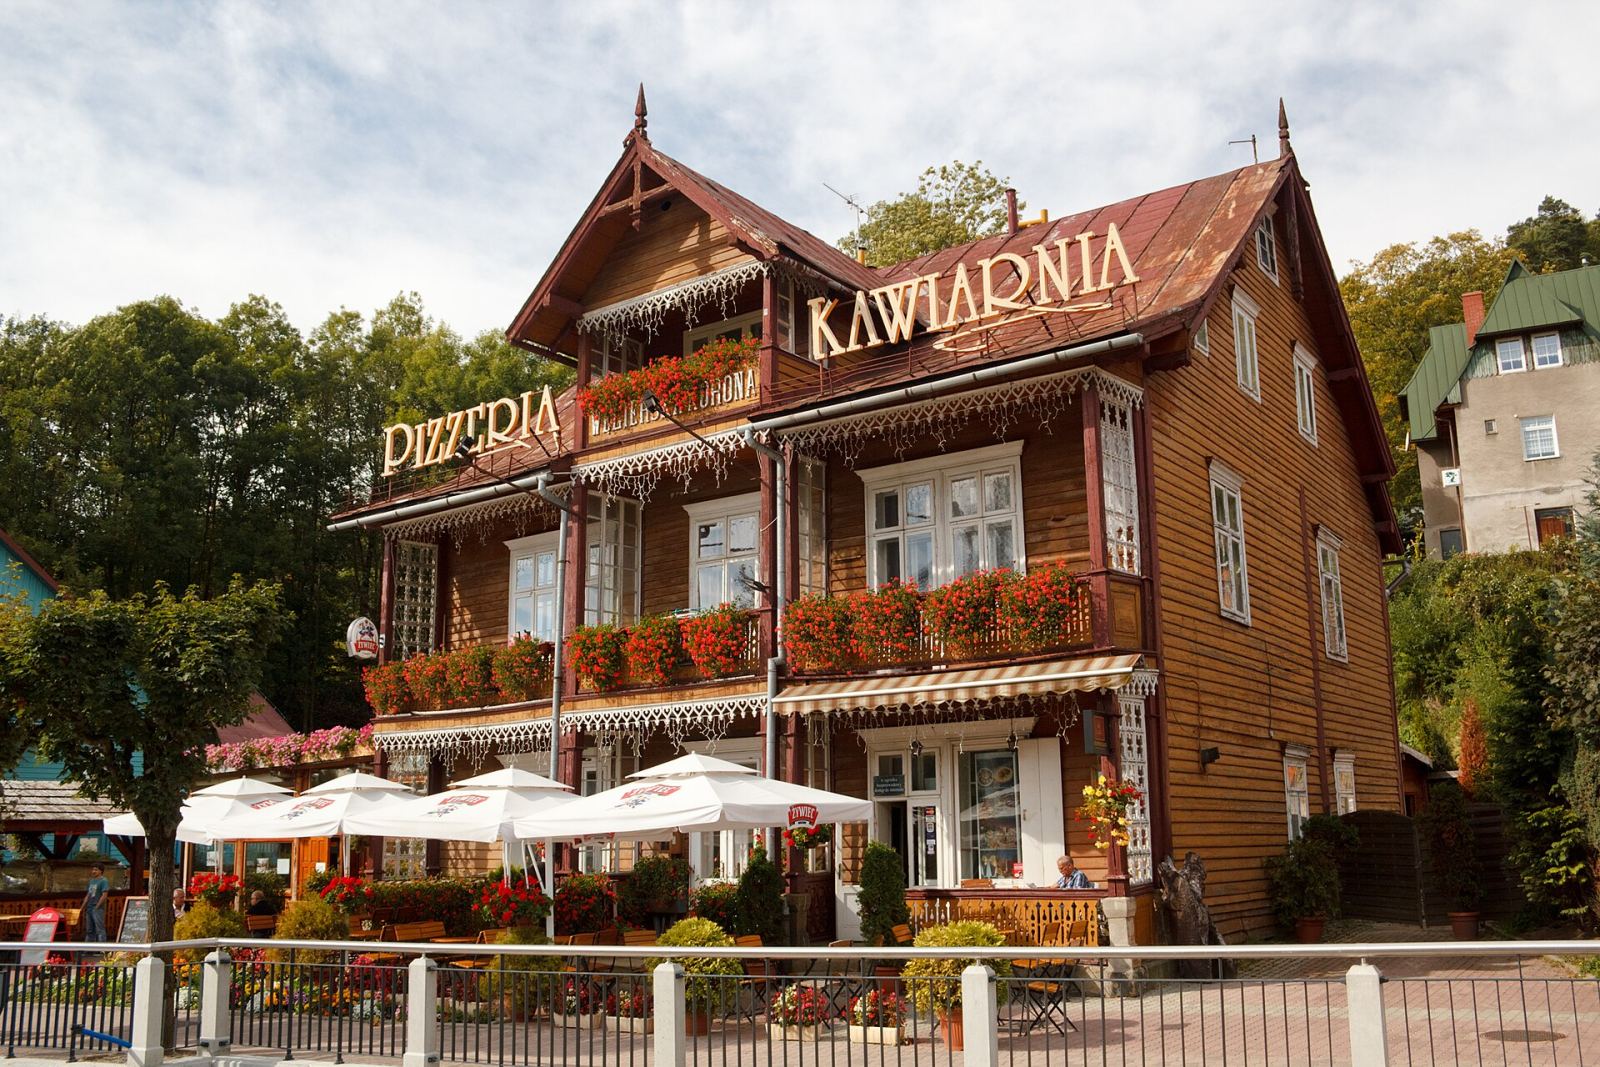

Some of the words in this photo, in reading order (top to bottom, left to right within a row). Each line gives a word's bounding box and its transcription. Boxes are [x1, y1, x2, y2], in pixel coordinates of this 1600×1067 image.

[807, 222, 1140, 360] KAWIARNIA
[381, 384, 560, 477] PIZZERIA
[687, 368, 757, 412] ORONA
